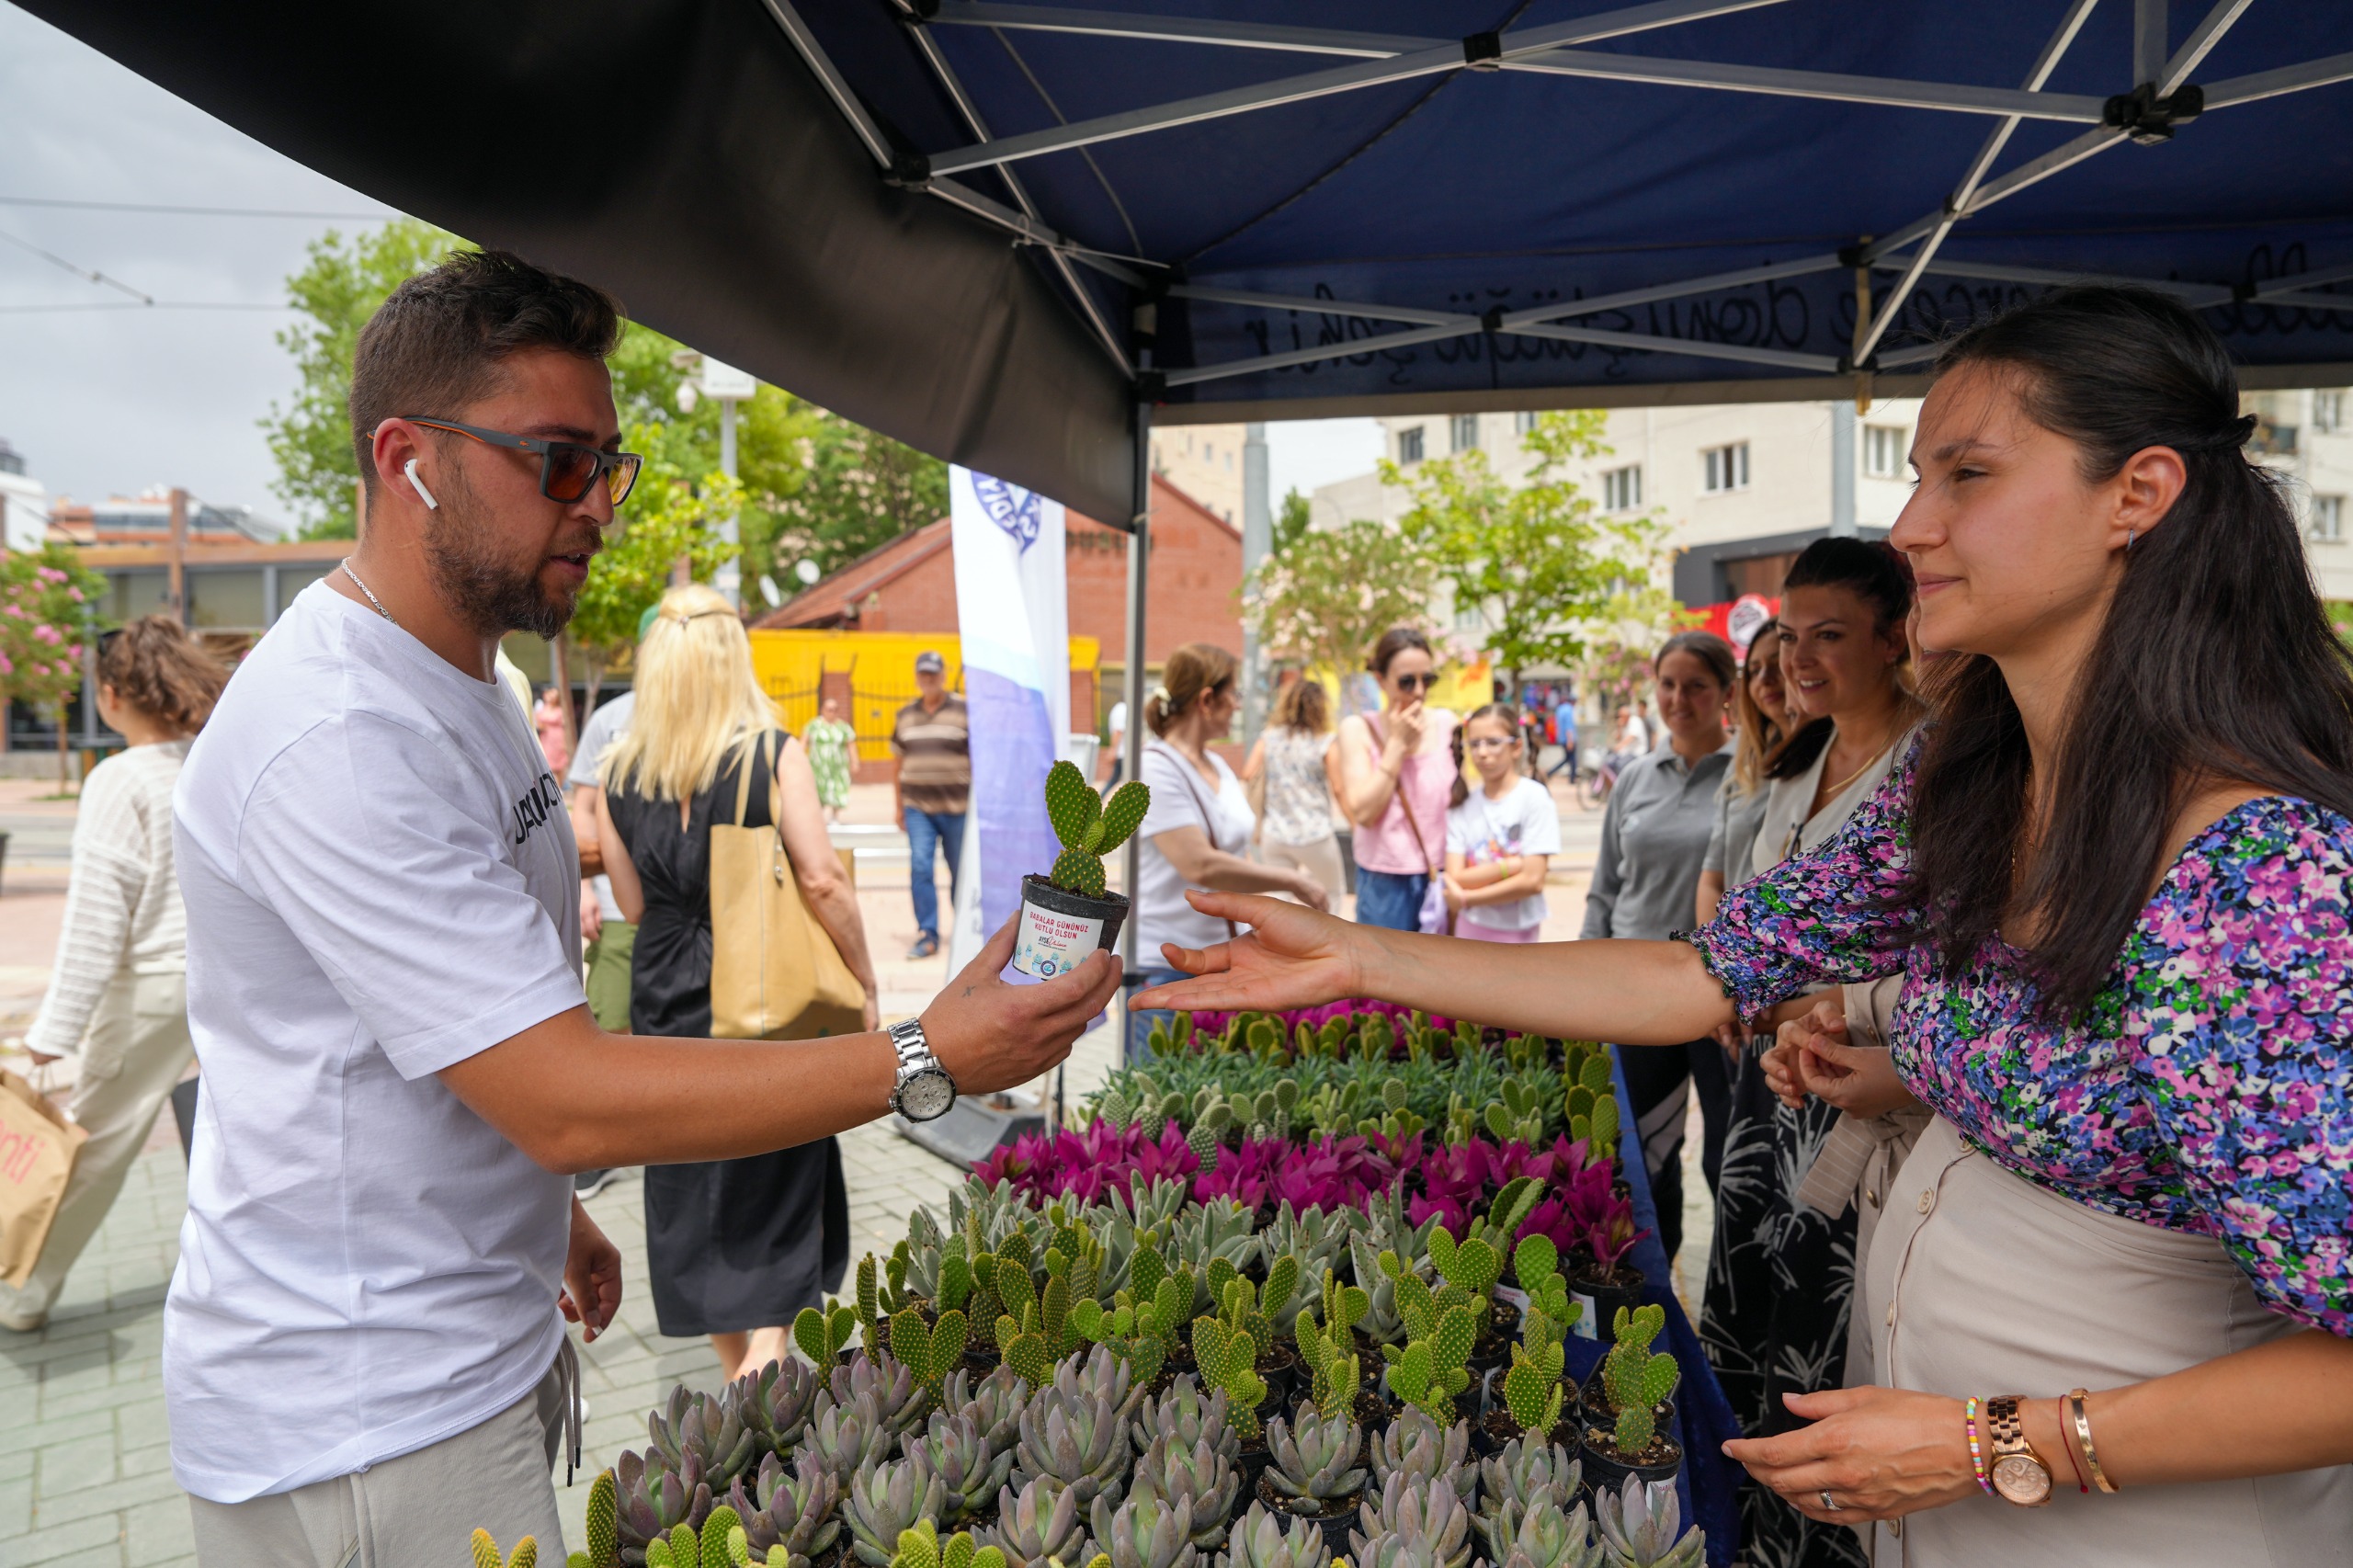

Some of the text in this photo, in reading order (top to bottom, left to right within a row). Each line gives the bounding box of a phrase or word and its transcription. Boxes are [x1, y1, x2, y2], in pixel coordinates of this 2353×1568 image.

[1029, 912, 1088, 933] BABALAR GÜNÜNÜZ
[1034, 923, 1077, 939] KUTLU OLSUN
